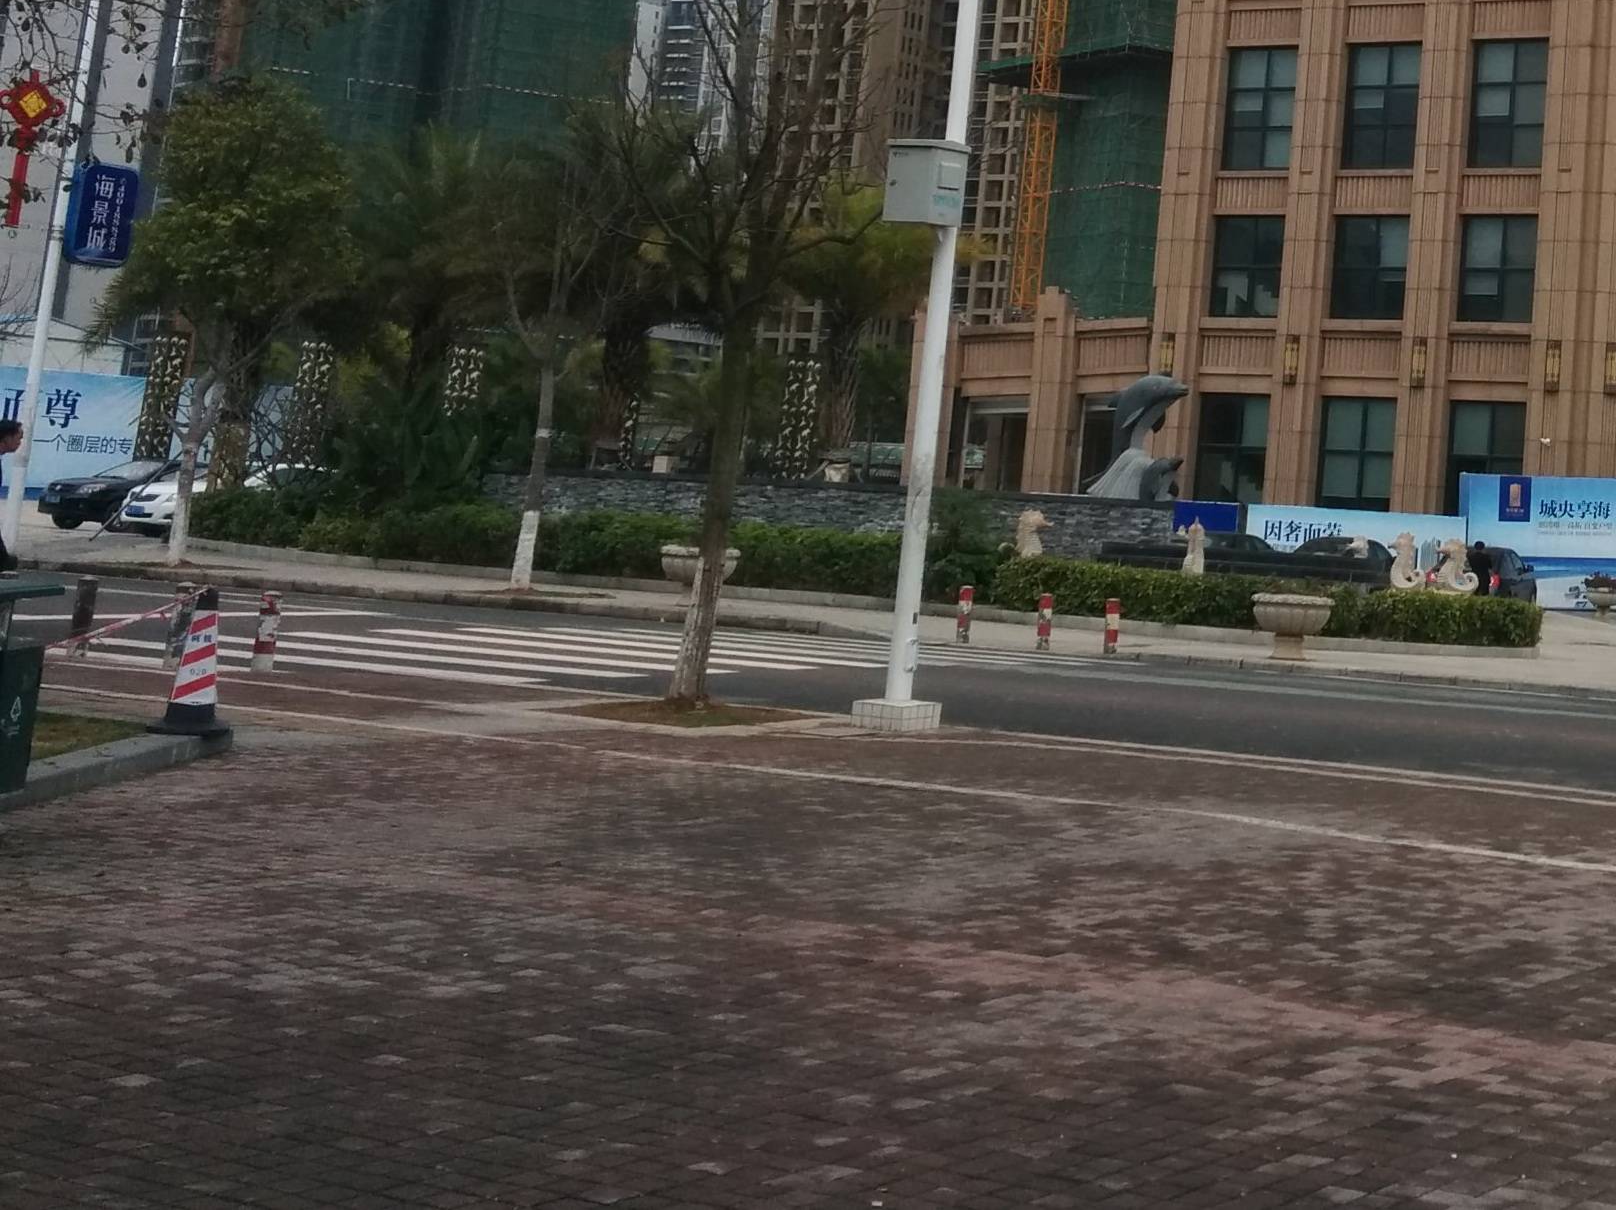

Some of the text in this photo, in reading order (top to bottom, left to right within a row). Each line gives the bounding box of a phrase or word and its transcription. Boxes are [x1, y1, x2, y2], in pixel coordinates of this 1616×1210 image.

[86, 174, 115, 250] 海景城
[1539, 500, 1610, 519] 城央享海
